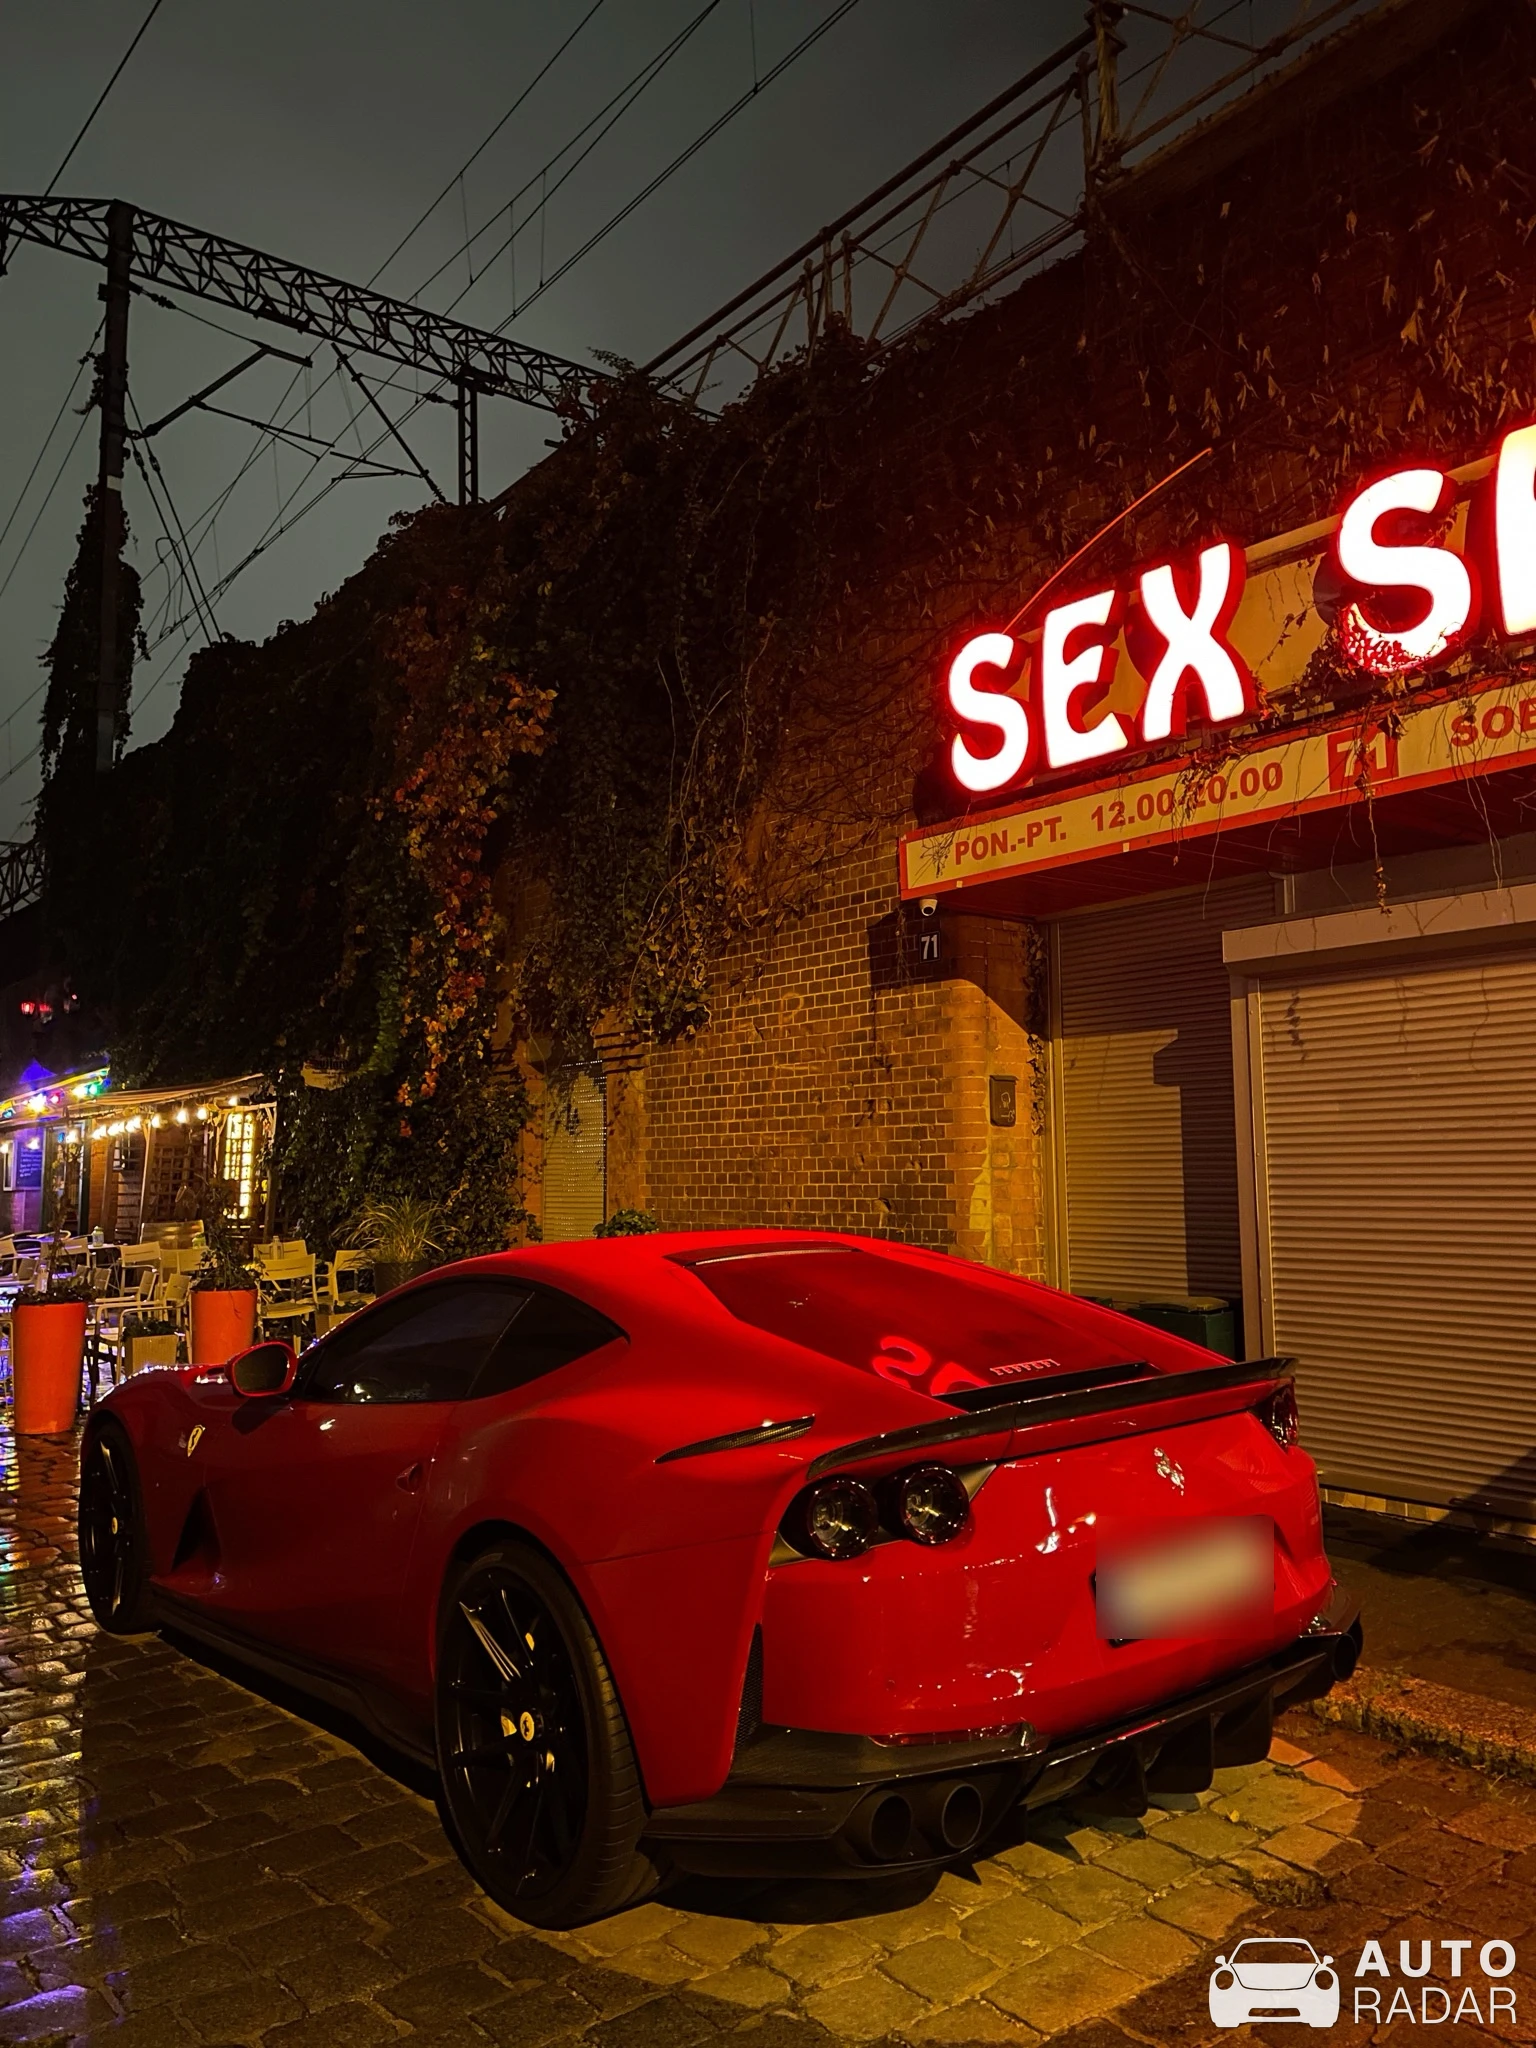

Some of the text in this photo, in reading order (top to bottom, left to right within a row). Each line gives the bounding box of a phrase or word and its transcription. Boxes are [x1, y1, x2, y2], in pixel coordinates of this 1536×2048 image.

[949, 542, 1245, 791] SEX
[955, 816, 1067, 866] PON.-PT.
[921, 934, 939, 960] 71
